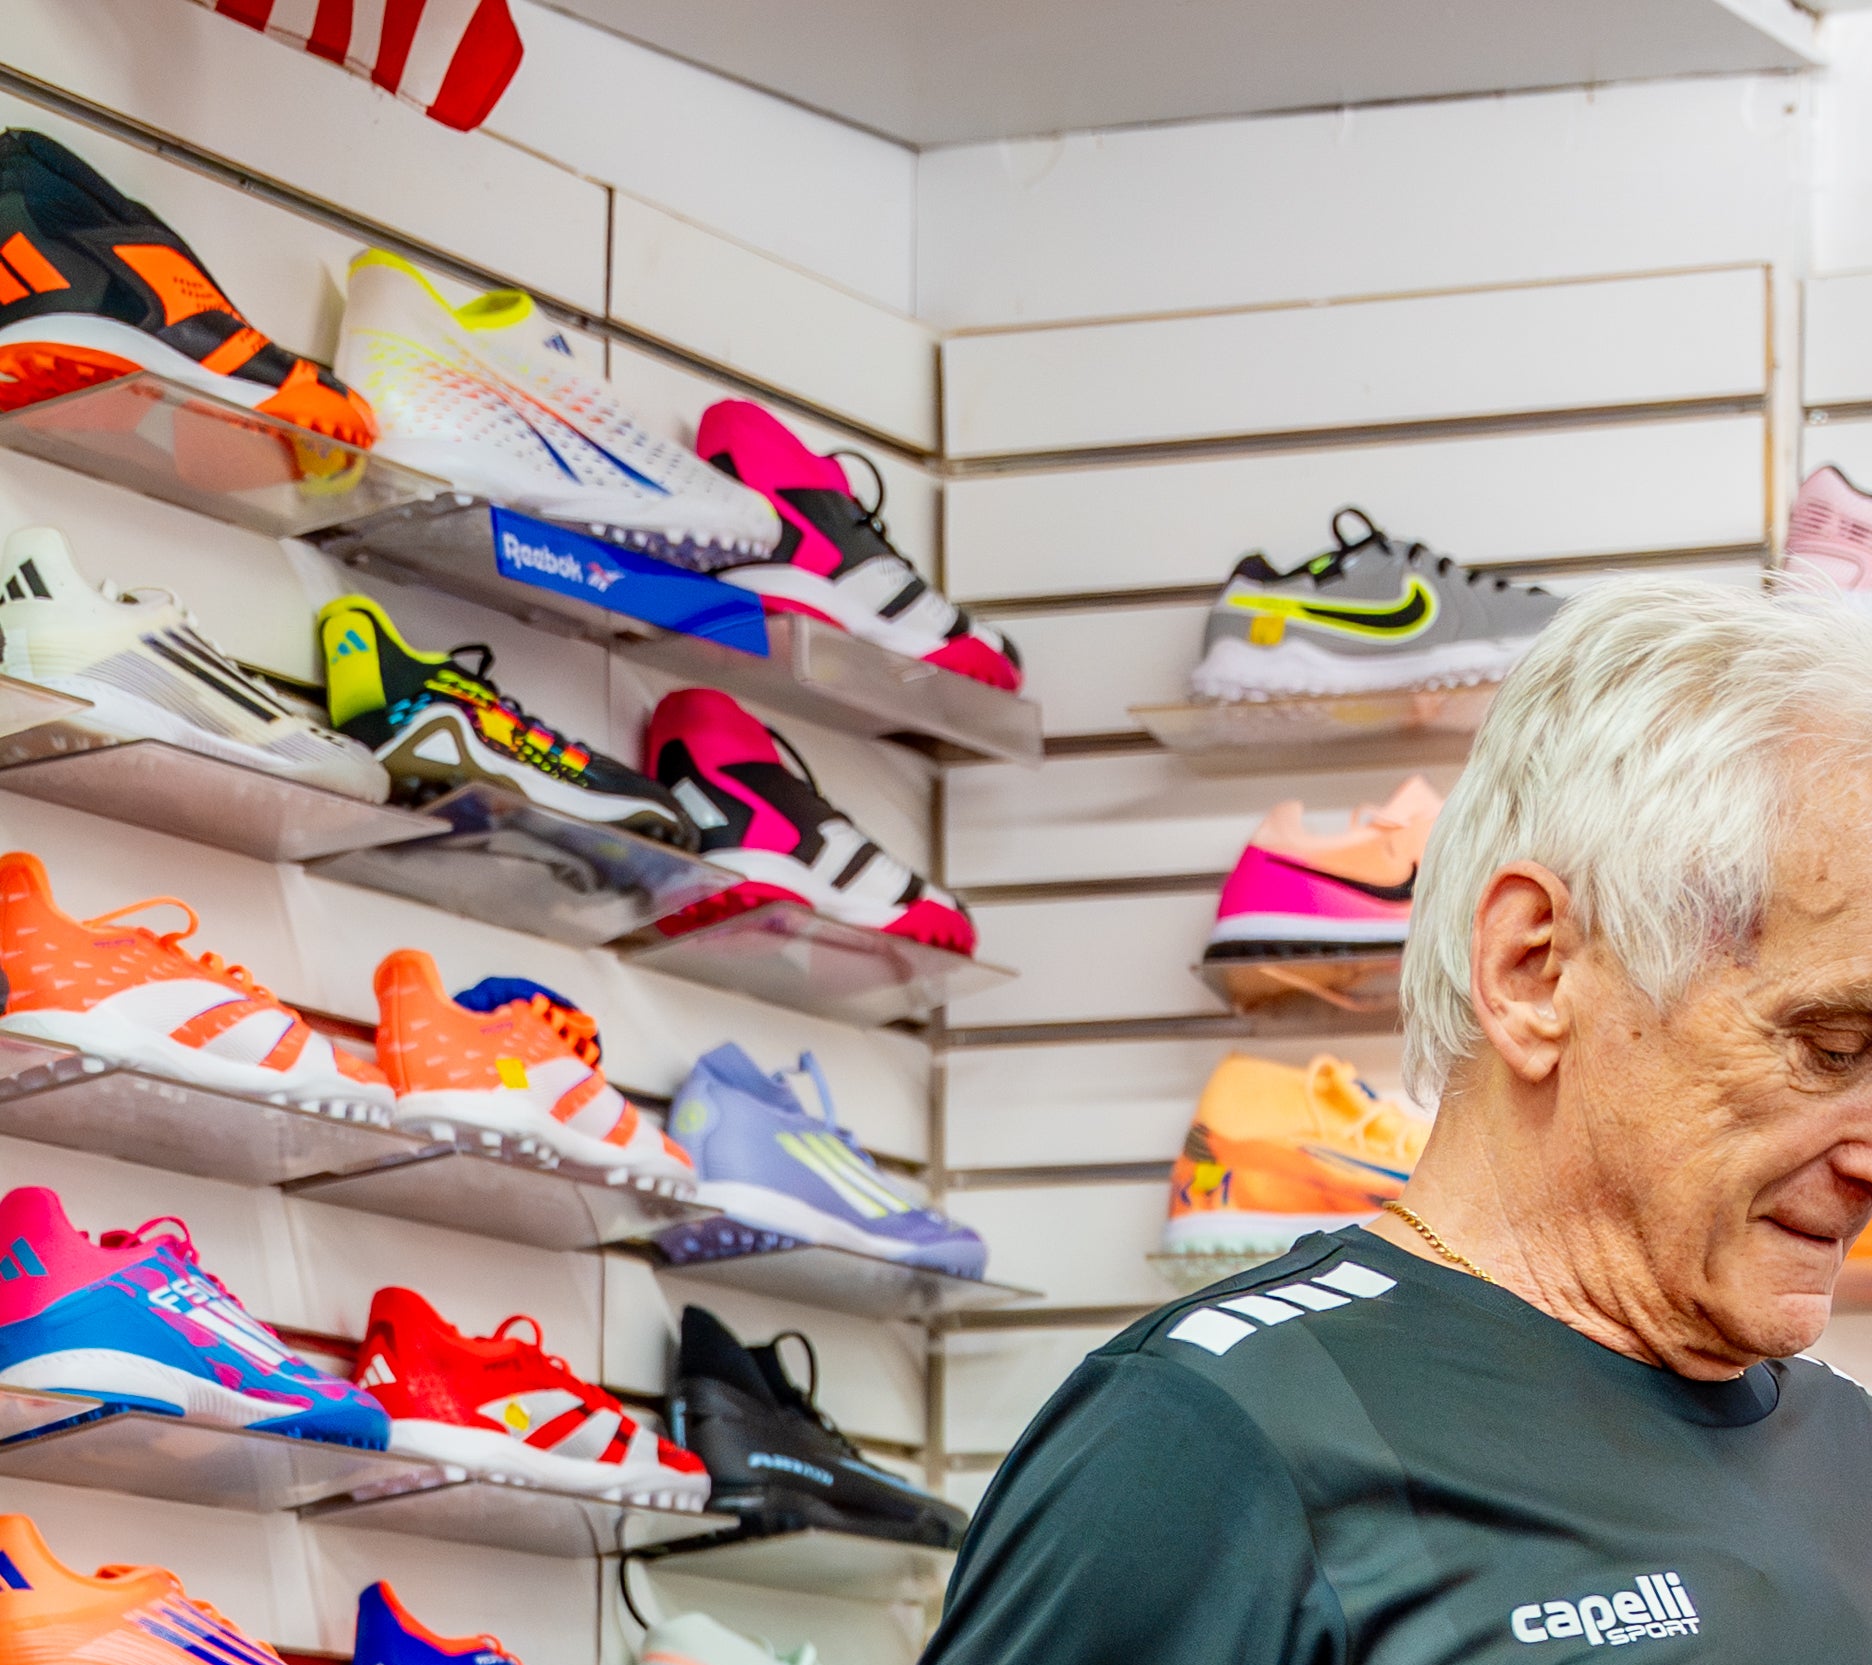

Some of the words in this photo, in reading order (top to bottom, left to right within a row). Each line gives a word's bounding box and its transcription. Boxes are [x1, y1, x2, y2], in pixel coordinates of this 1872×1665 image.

[502, 531, 584, 584] Reebok
[1511, 1572, 1697, 1646] capelli
[1606, 1617, 1699, 1645] SPORT
